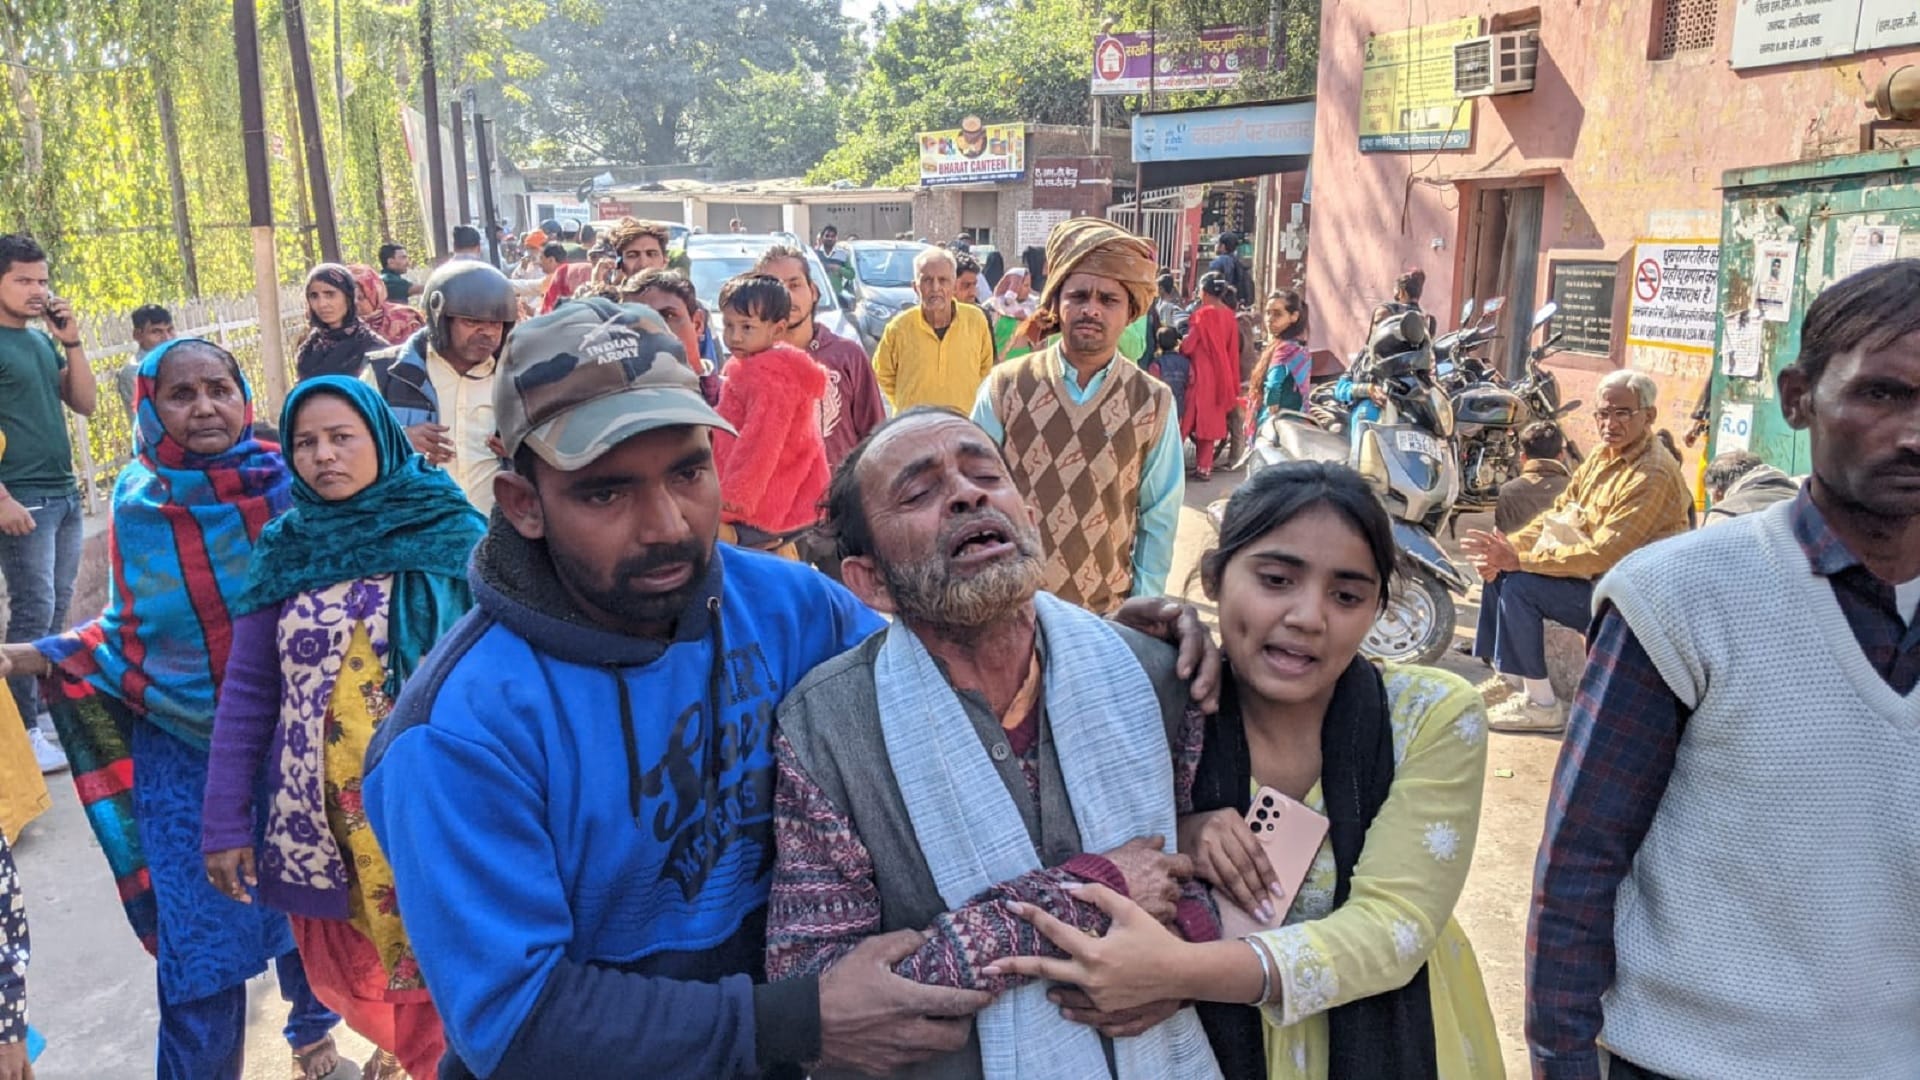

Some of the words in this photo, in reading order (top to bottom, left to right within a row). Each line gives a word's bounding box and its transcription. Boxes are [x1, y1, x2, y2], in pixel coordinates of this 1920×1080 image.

[938, 161, 969, 175] BHARAT
[970, 158, 1008, 173] CANTEEN
[586, 337, 638, 357] INDIAN
[598, 347, 639, 365] ARMY
